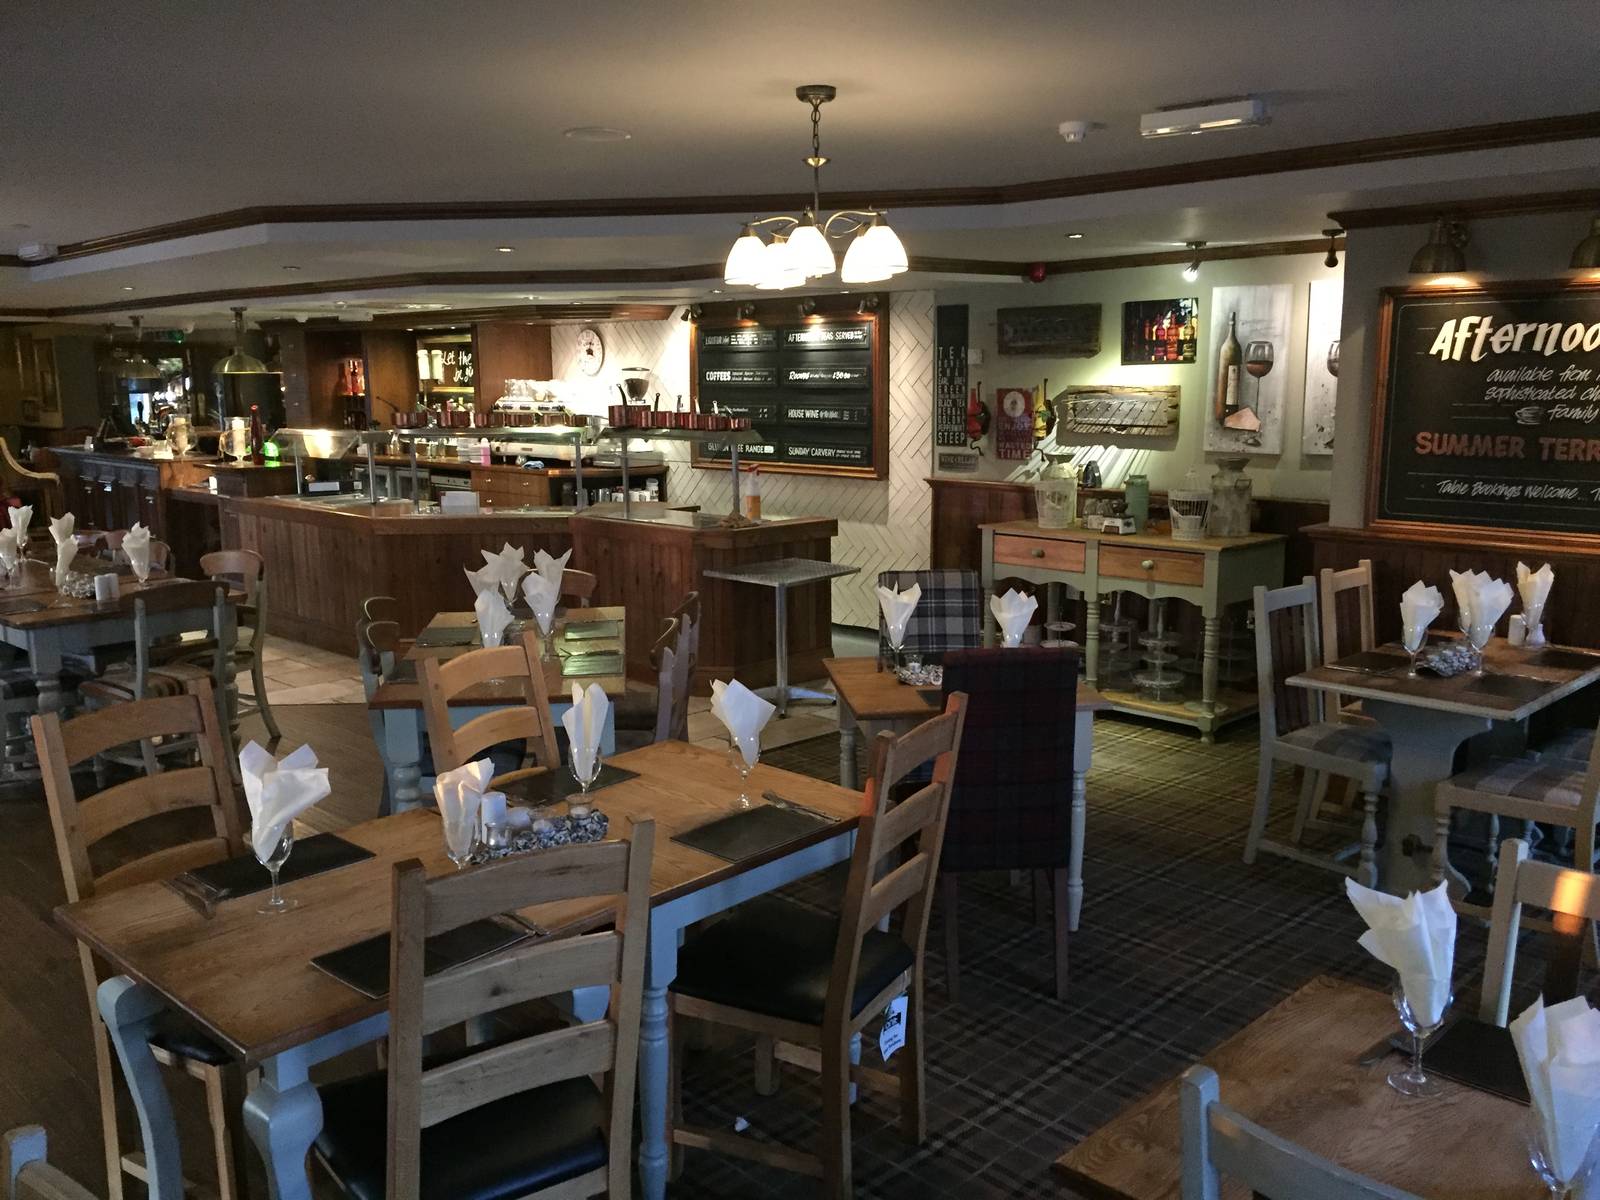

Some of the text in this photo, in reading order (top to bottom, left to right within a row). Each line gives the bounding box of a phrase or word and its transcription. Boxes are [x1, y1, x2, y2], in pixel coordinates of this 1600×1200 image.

[441, 350, 473, 366] Let the
[938, 346, 966, 360] TEA
[705, 371, 731, 382] COFFEES
[1486, 366, 1554, 382] available
[1559, 364, 1593, 382] from
[788, 409, 804, 418] HOUSE
[805, 410, 819, 419] WINE
[938, 432, 966, 444] STEEP
[745, 445, 764, 454] RANGE
[1415, 431, 1526, 458] SUMMER
[788, 447, 811, 456] SUNDAY
[811, 448, 836, 457] CARVERY
[999, 449, 1031, 459] TIME
[1436, 479, 1470, 495] Table
[1471, 480, 1522, 500] Bookings
